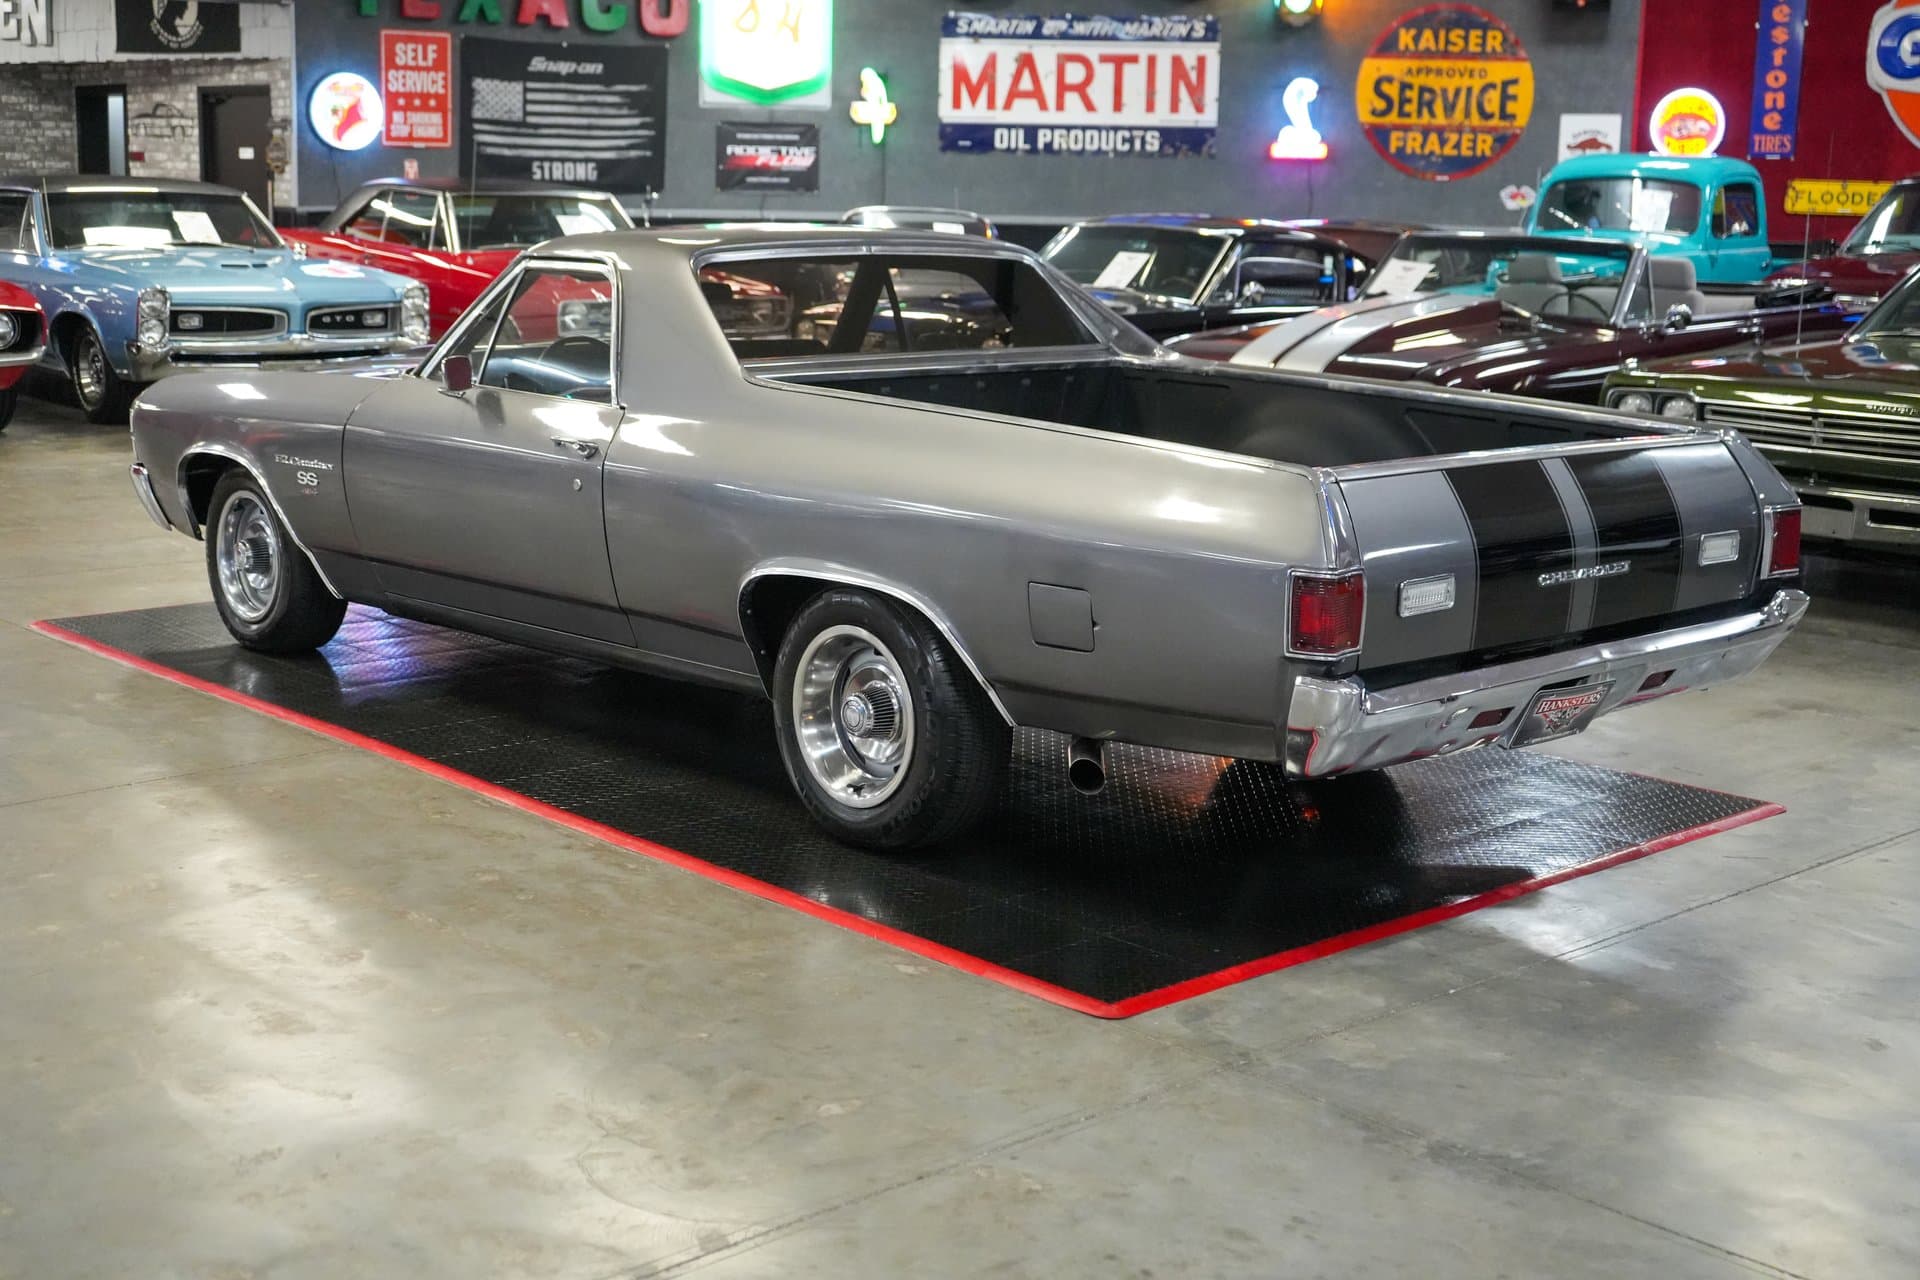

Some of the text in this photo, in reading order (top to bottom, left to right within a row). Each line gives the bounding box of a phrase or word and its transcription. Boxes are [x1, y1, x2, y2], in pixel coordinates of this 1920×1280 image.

[1398, 27, 1504, 53] KAISER
[395, 42, 438, 67] SELF
[388, 69, 446, 95] SERVICE
[951, 52, 1207, 115] MARTIN
[1405, 65, 1489, 80] APPROVED
[1370, 74, 1519, 122] SERVICE
[994, 127, 1161, 153] OIL PRODUCTS
[1389, 130, 1494, 158] FRAZER
[1753, 133, 1792, 153] TIRES
[531, 161, 598, 182] STRONG
[1795, 190, 1886, 207] FLOODE
[297, 470, 319, 486] SS
[1538, 561, 1632, 586] CHEVROLET
